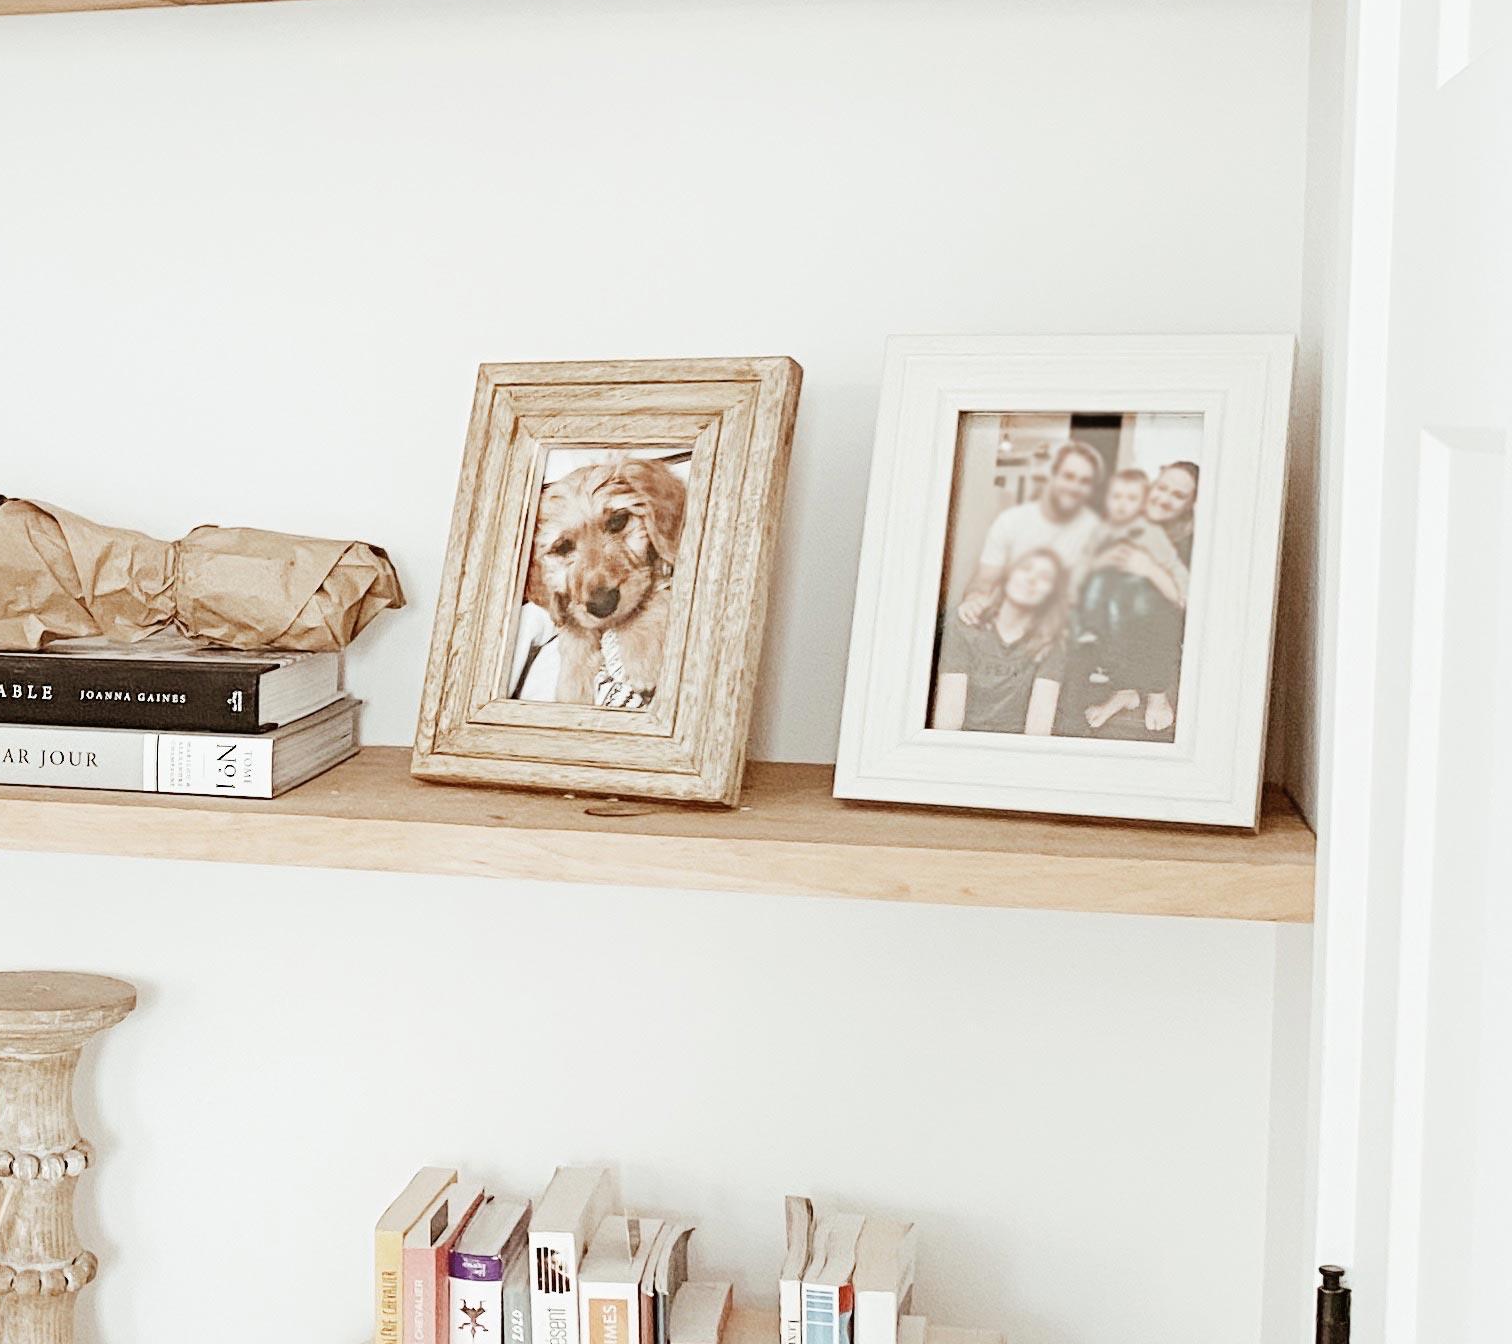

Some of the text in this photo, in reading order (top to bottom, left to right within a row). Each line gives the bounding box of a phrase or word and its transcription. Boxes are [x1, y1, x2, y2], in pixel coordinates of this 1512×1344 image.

[80, 689, 187, 704] JOANNA GAINES
[39, 749, 98, 768] JOUR
[413, 1278, 425, 1340] CHEVALIER
[512, 1309, 524, 1342] 2020
